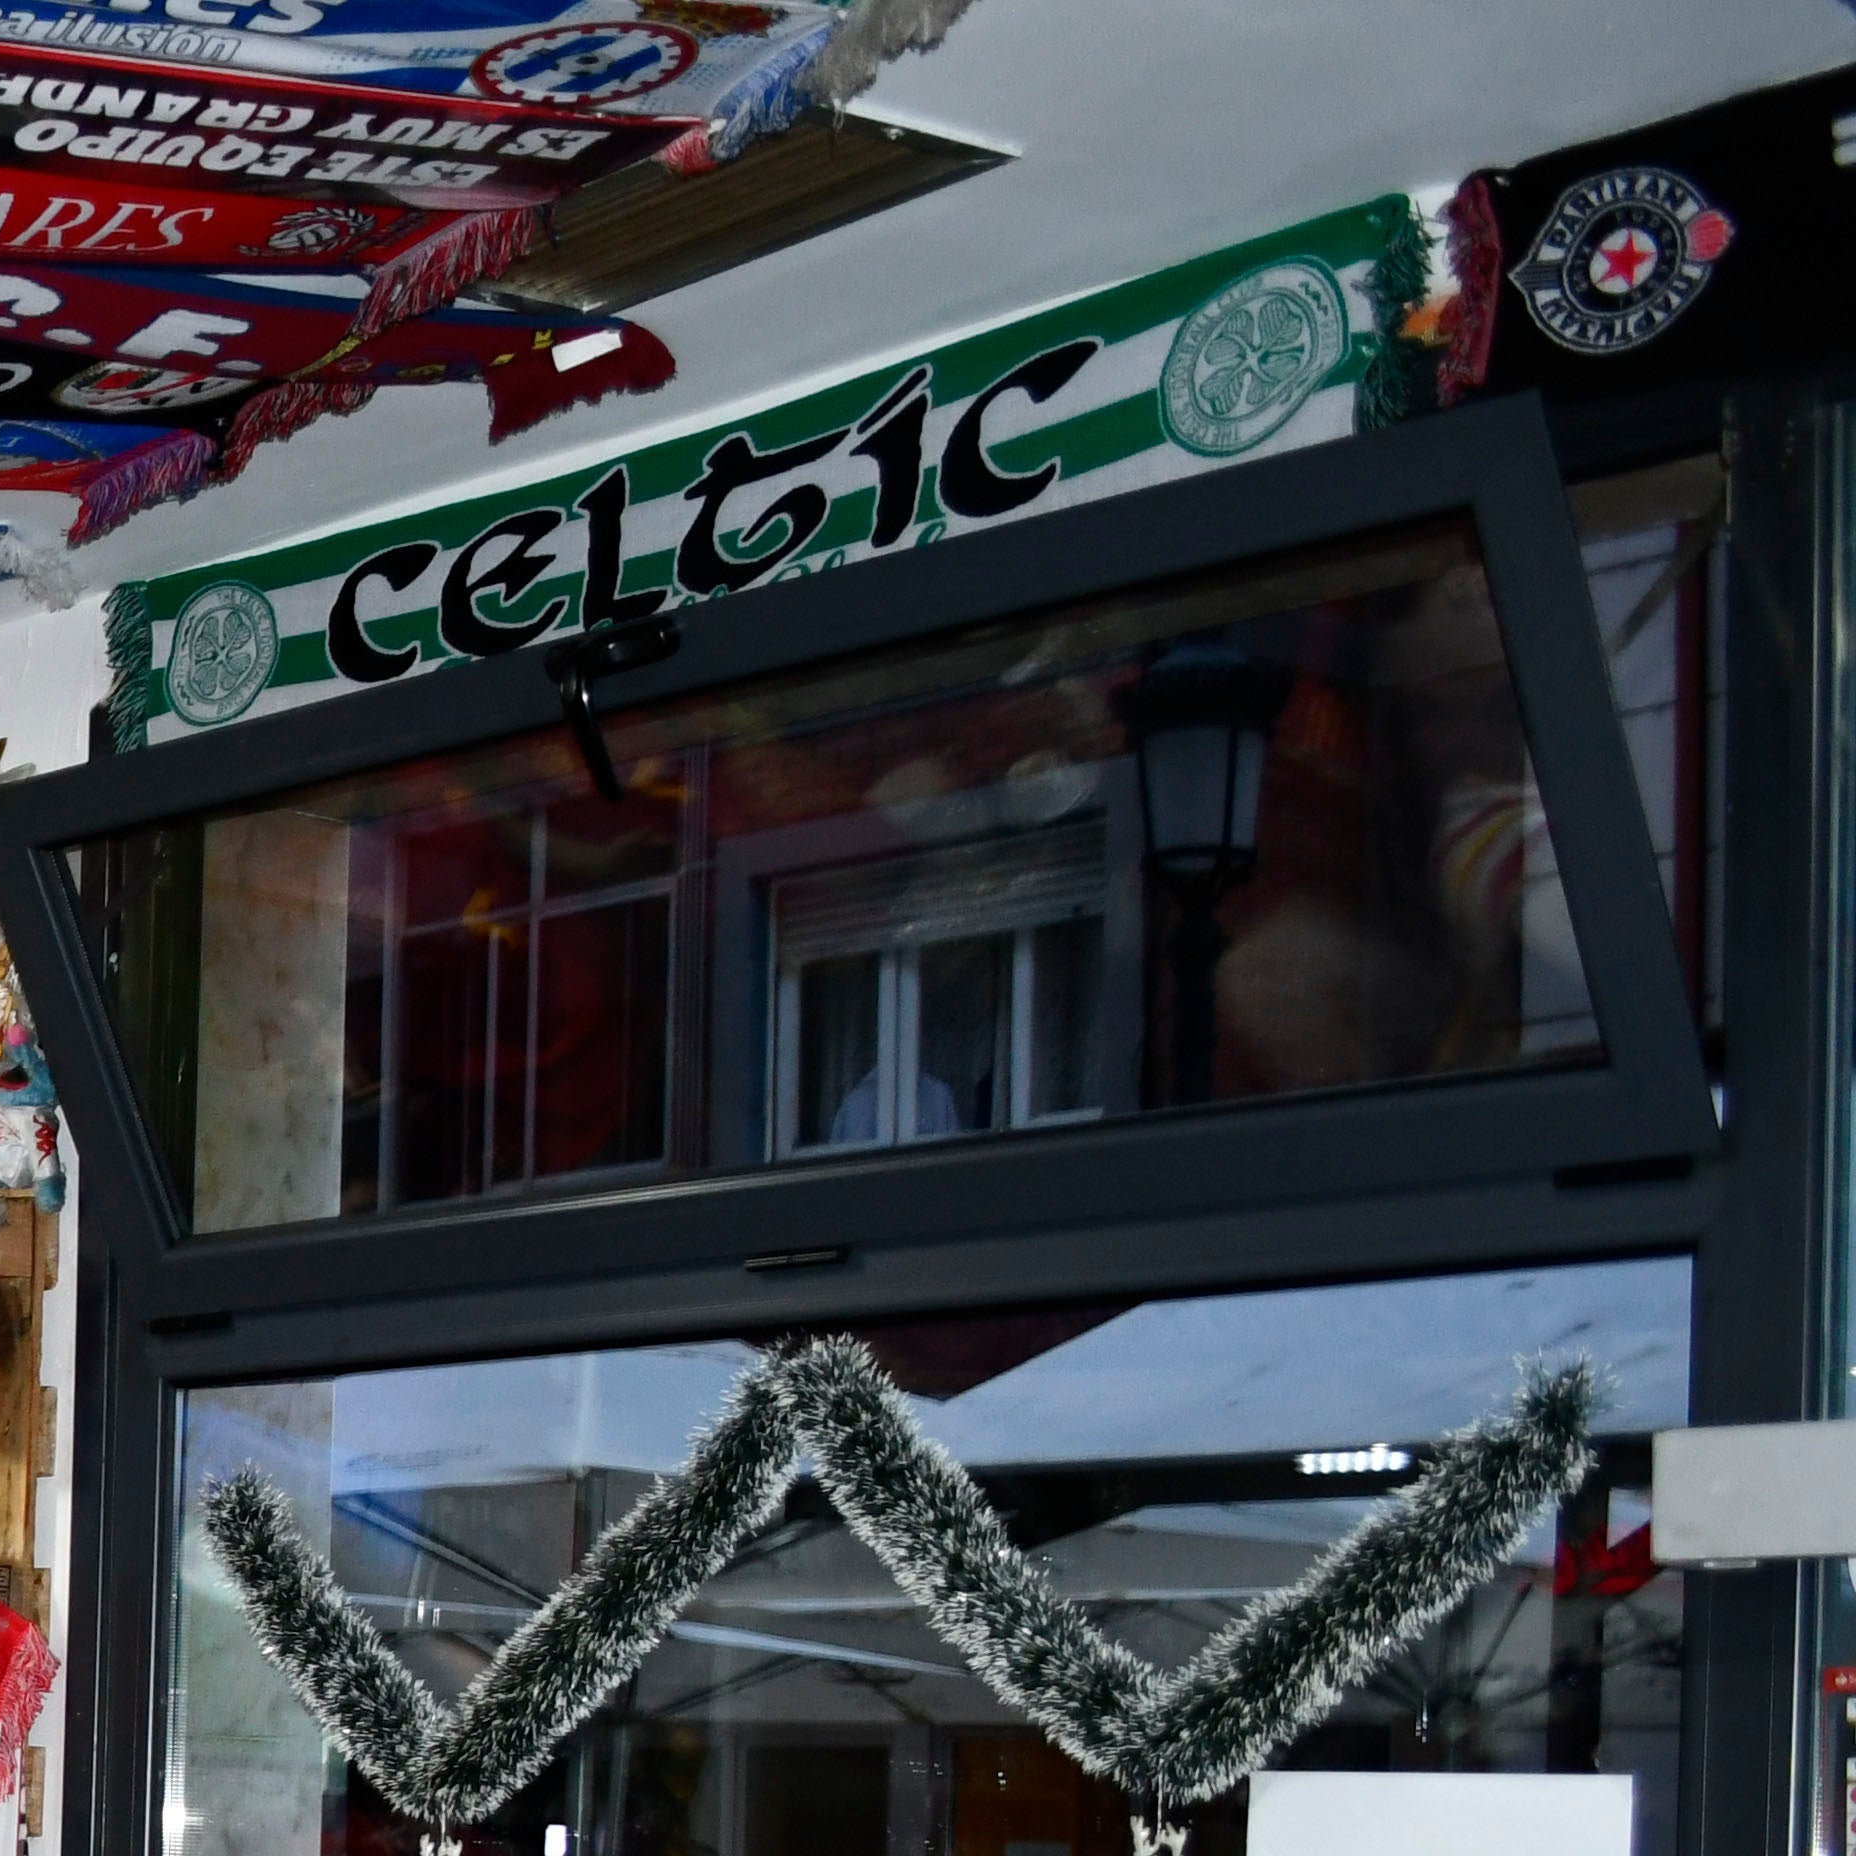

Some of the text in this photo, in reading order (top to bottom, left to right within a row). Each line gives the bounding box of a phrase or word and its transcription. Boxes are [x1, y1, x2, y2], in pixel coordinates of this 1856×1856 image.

[44, 14, 241, 64] ilusión
[12, 119, 499, 188] ESTE EQUIPO
[318, 110, 492, 152] MUY
[506, 126, 612, 162] ES
